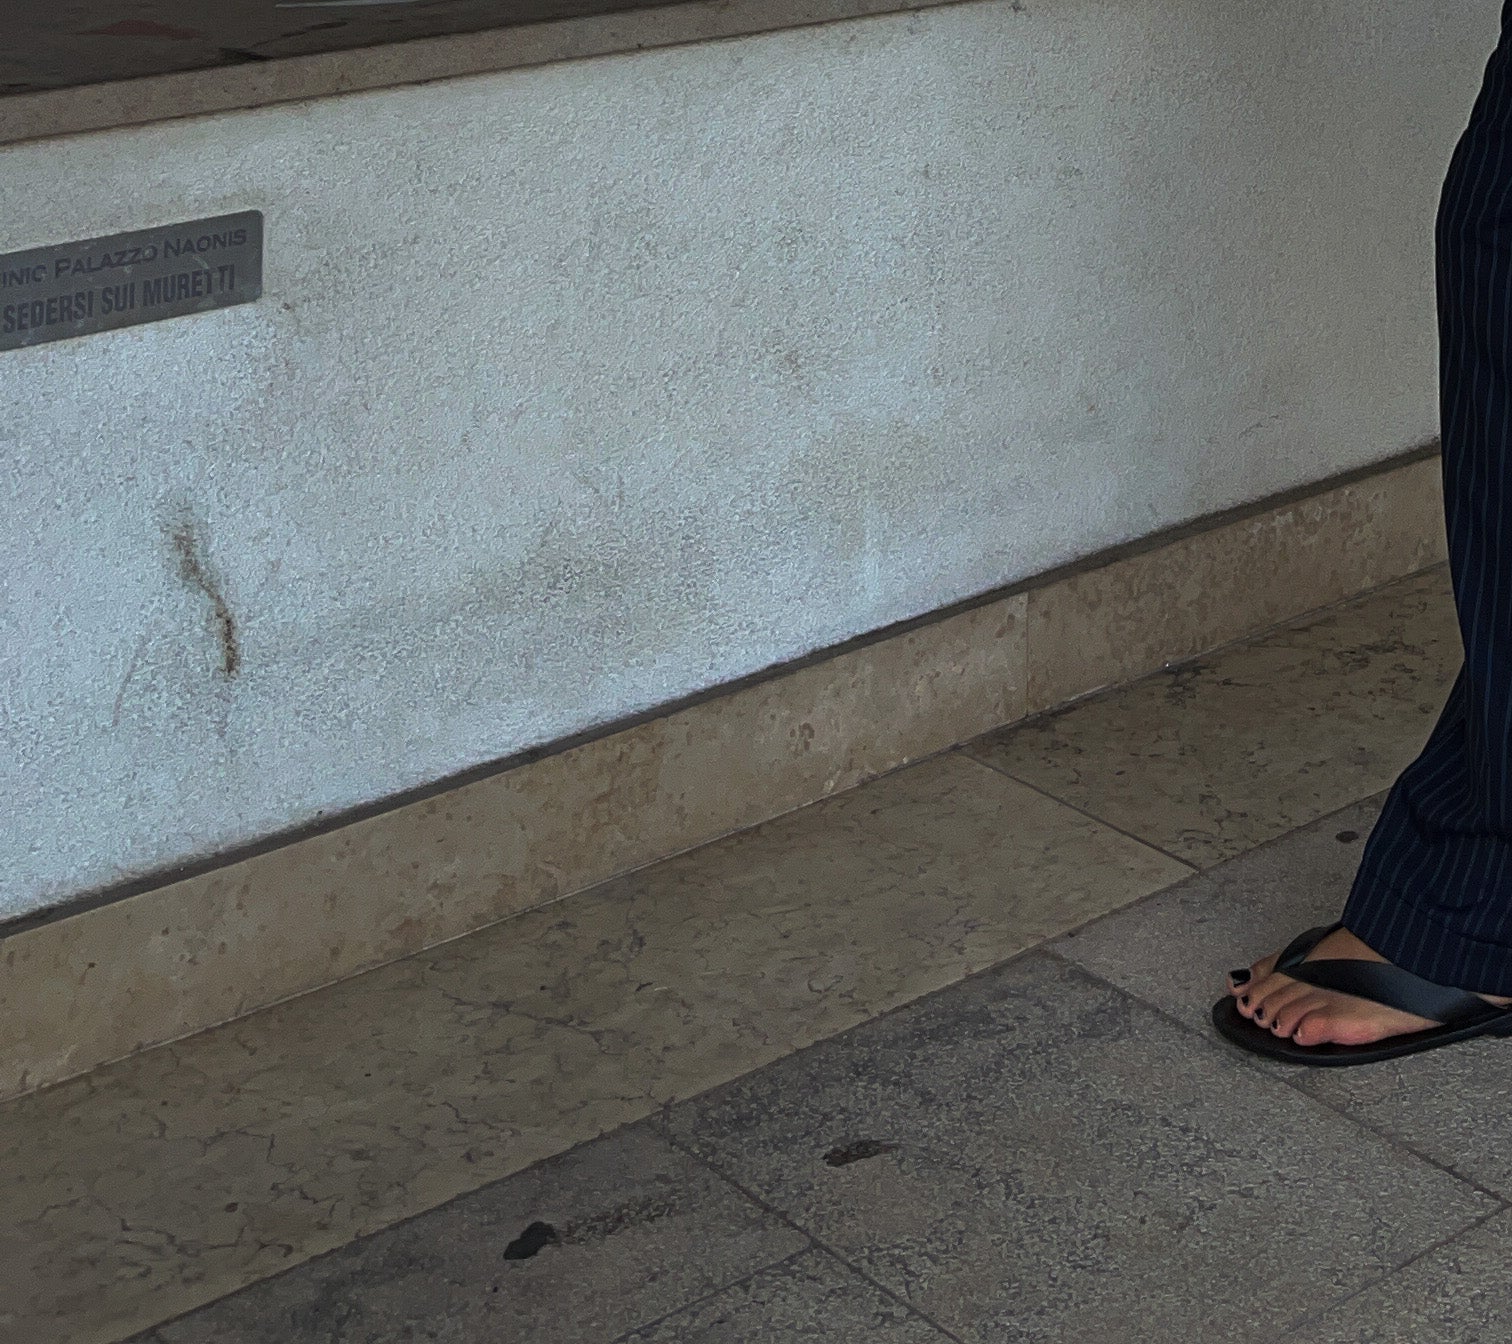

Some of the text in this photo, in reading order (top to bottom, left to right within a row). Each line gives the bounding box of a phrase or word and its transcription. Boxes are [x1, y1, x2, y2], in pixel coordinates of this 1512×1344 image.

[55, 244, 158, 279] PALAZZO
[164, 229, 247, 258] NAONIS
[3, 264, 236, 333] SEDERSI SUI MURETTI
